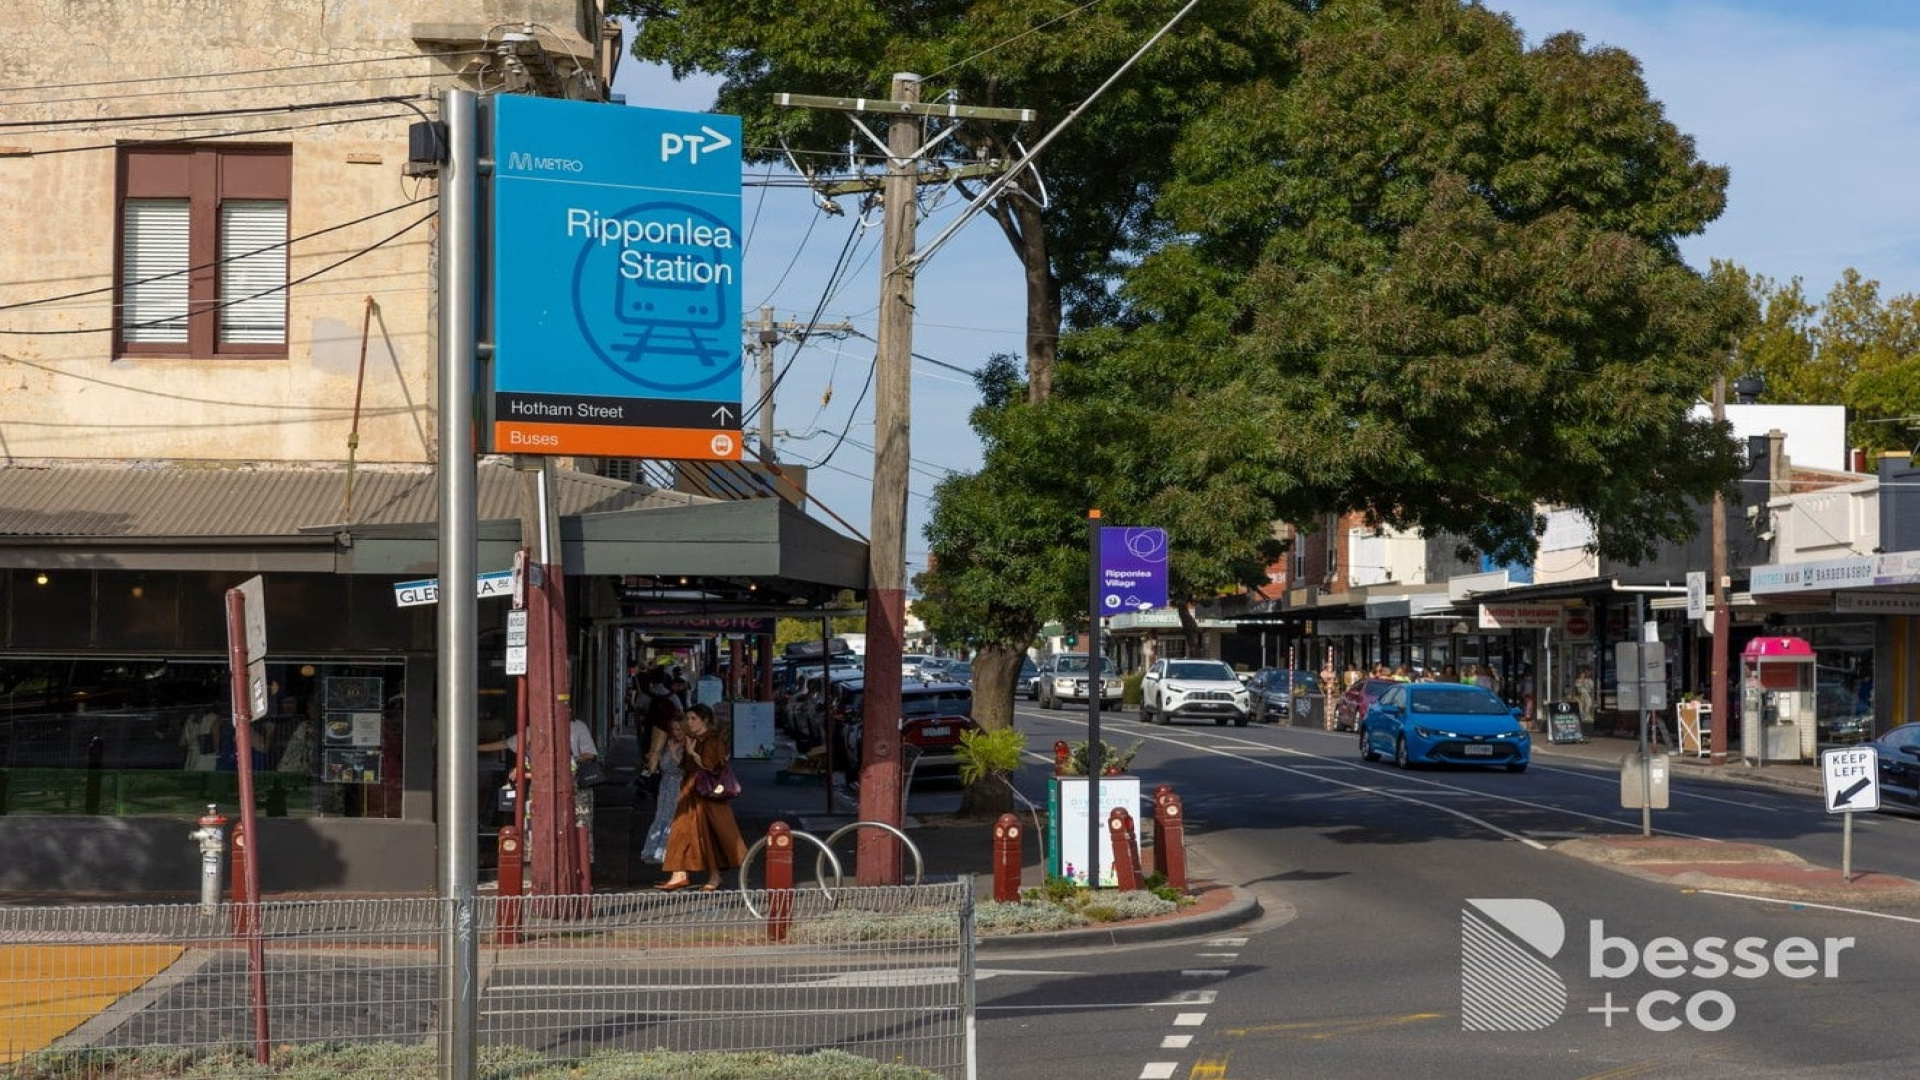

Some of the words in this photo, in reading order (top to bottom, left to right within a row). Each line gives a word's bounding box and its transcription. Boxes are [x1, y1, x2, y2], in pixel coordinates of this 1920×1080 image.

[534, 157, 583, 172] METRO
[567, 207, 733, 249] Ripponlea
[620, 250, 732, 285] Station
[511, 401, 573, 417] Hotham
[577, 403, 624, 419] Street
[510, 431, 559, 446] Buses
[1105, 569, 1152, 580] Ripponlea
[1105, 579, 1136, 588] Village
[1832, 753, 1867, 765] KEEP
[1834, 766, 1866, 777] LEFT
